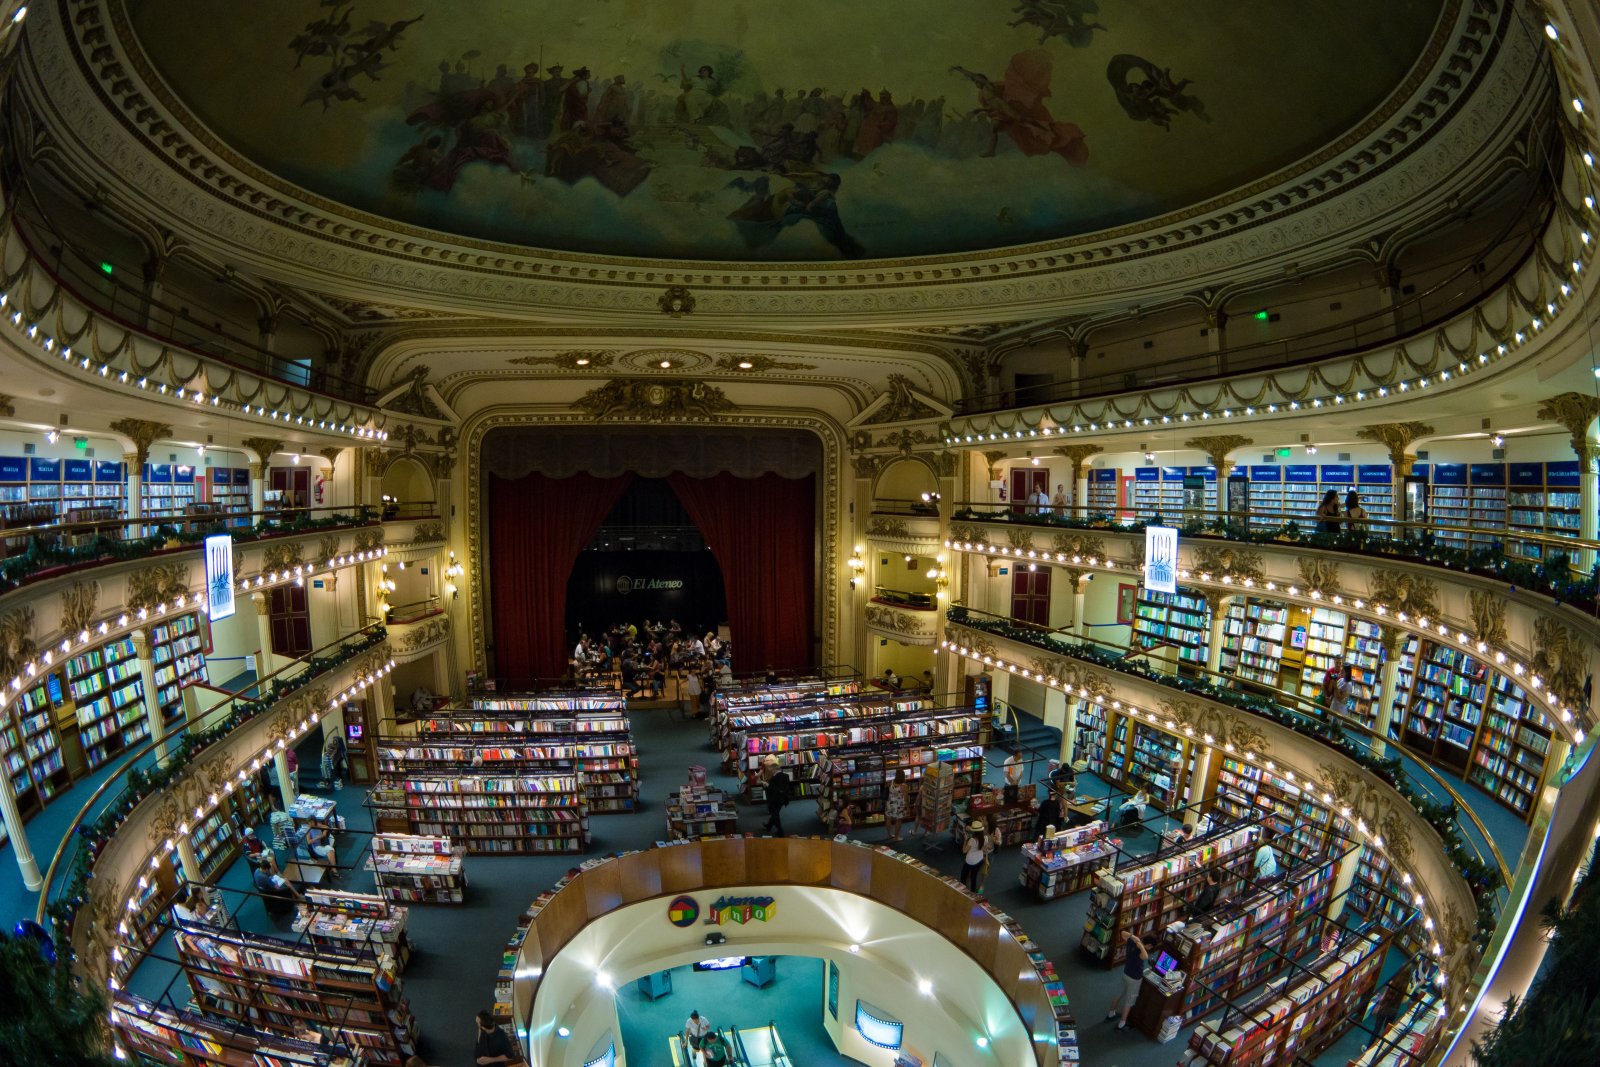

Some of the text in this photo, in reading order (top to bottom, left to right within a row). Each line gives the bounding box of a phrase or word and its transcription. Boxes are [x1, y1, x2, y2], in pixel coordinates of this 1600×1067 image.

[633, 578, 683, 590] El Ateneo
[714, 895, 774, 906] Ateneo
[711, 908, 774, 922] Junior
